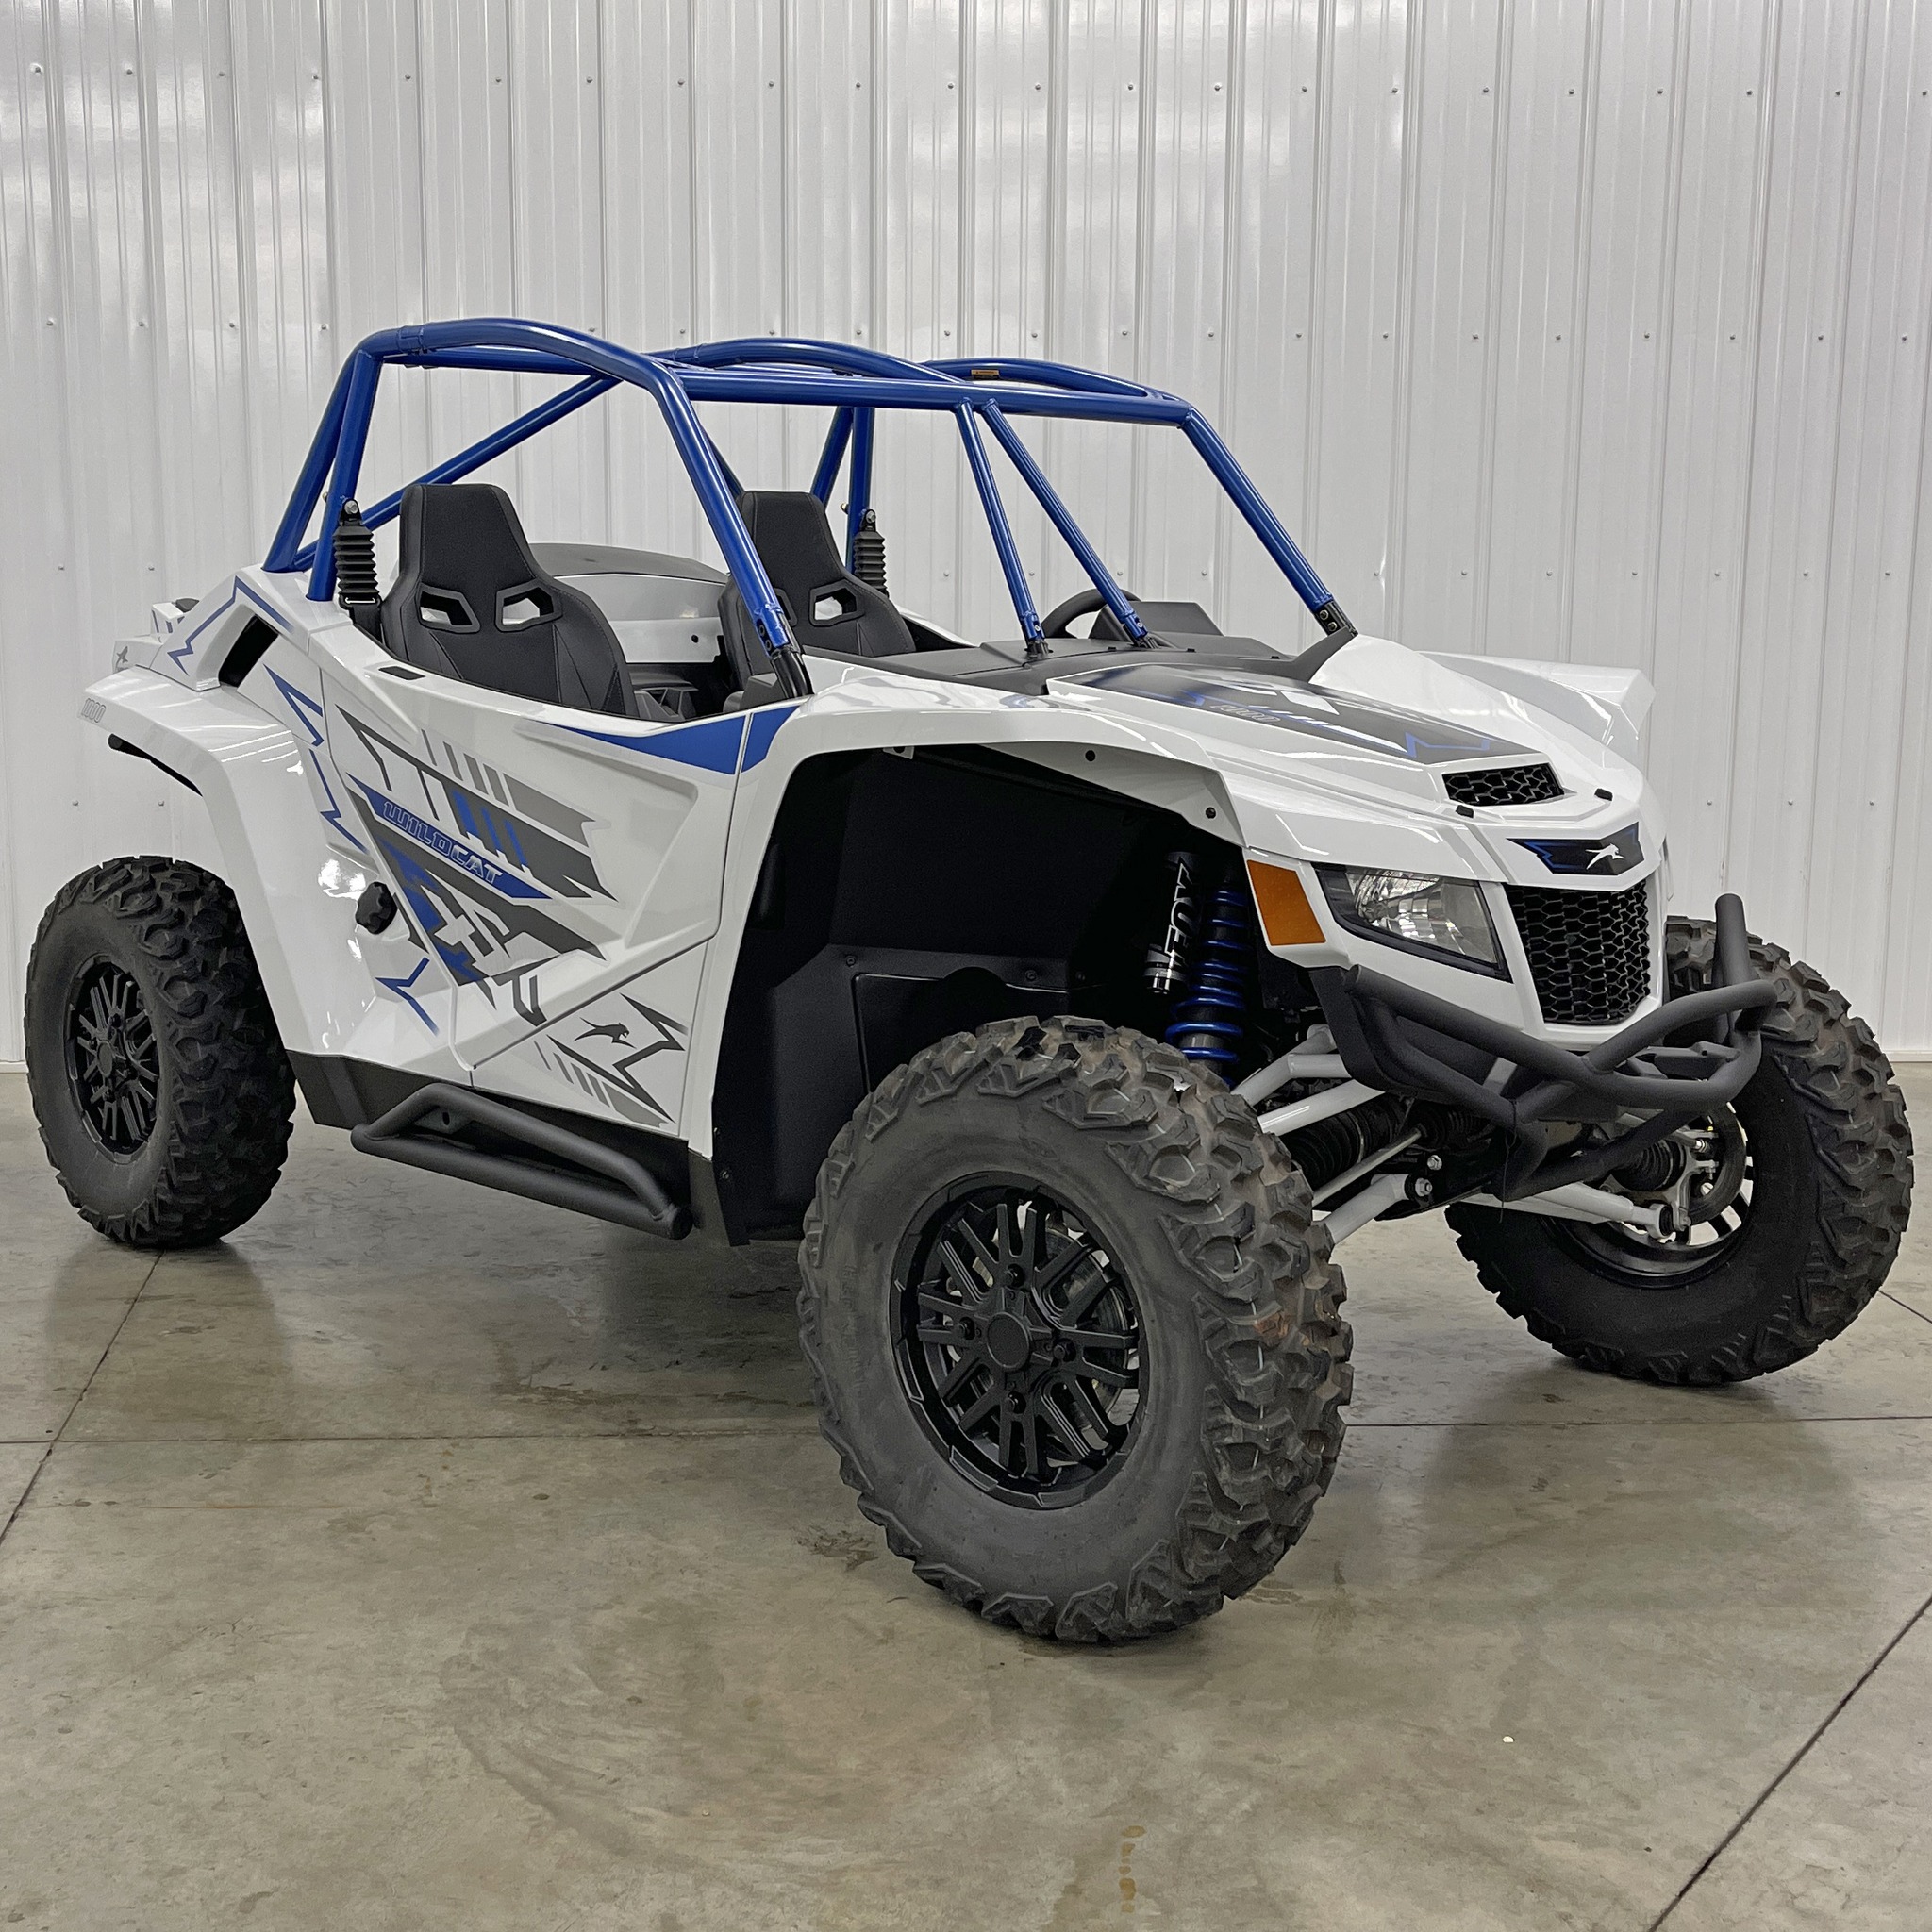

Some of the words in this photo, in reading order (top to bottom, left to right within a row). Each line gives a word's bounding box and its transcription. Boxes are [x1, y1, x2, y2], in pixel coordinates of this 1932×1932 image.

[80, 698, 107, 724] 1000
[384, 802, 503, 884] WILDCAT
[1163, 858, 1197, 966] FOX
